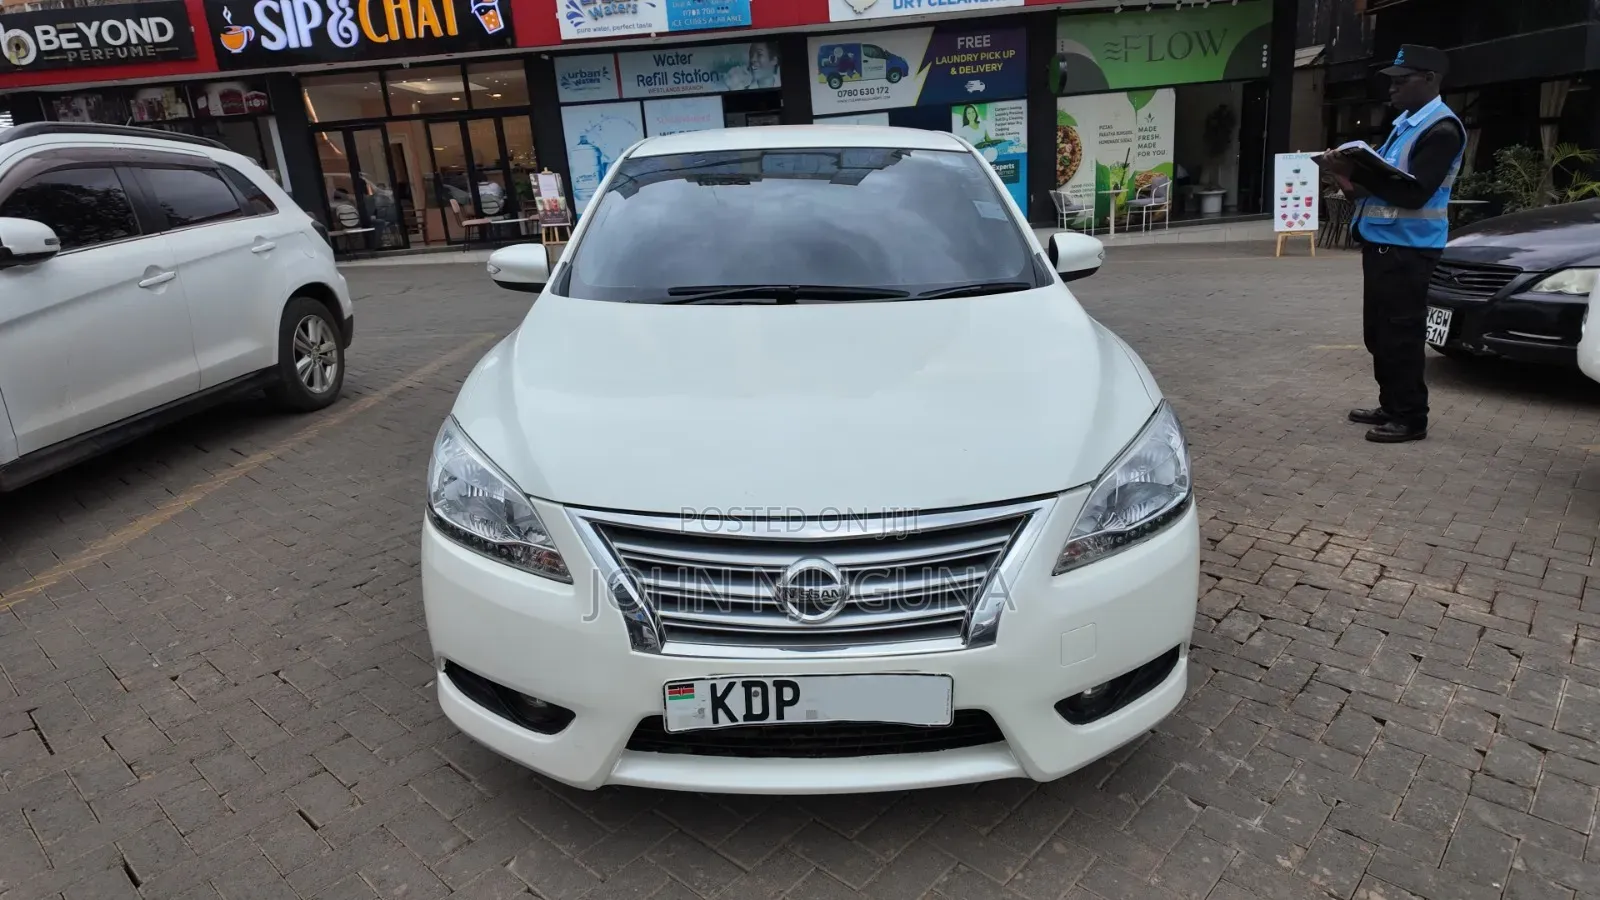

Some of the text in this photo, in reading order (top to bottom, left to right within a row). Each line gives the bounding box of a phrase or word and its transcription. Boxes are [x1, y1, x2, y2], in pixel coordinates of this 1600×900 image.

[588, 3, 639, 21] Waters
[254, 0, 323, 50] SIP
[576, 25, 592, 34] pure
[612, 23, 635, 32] perfect
[34, 17, 174, 51] BEYOND
[957, 34, 991, 49] FREE
[66, 45, 156, 62] PERFUME
[653, 53, 693, 67] Water
[936, 49, 1016, 65] LAUNDRY PICK UP
[568, 69, 600, 79] urban
[949, 63, 1003, 75] & DELIVERY
[636, 69, 719, 87] Refill Station
[837, 86, 889, 98] 0780 630 172
[991, 163, 1015, 171] Experts
[1428, 308, 1451, 328] KBW
[784, 587, 843, 600] NISSAN
[710, 680, 801, 724] KDP
